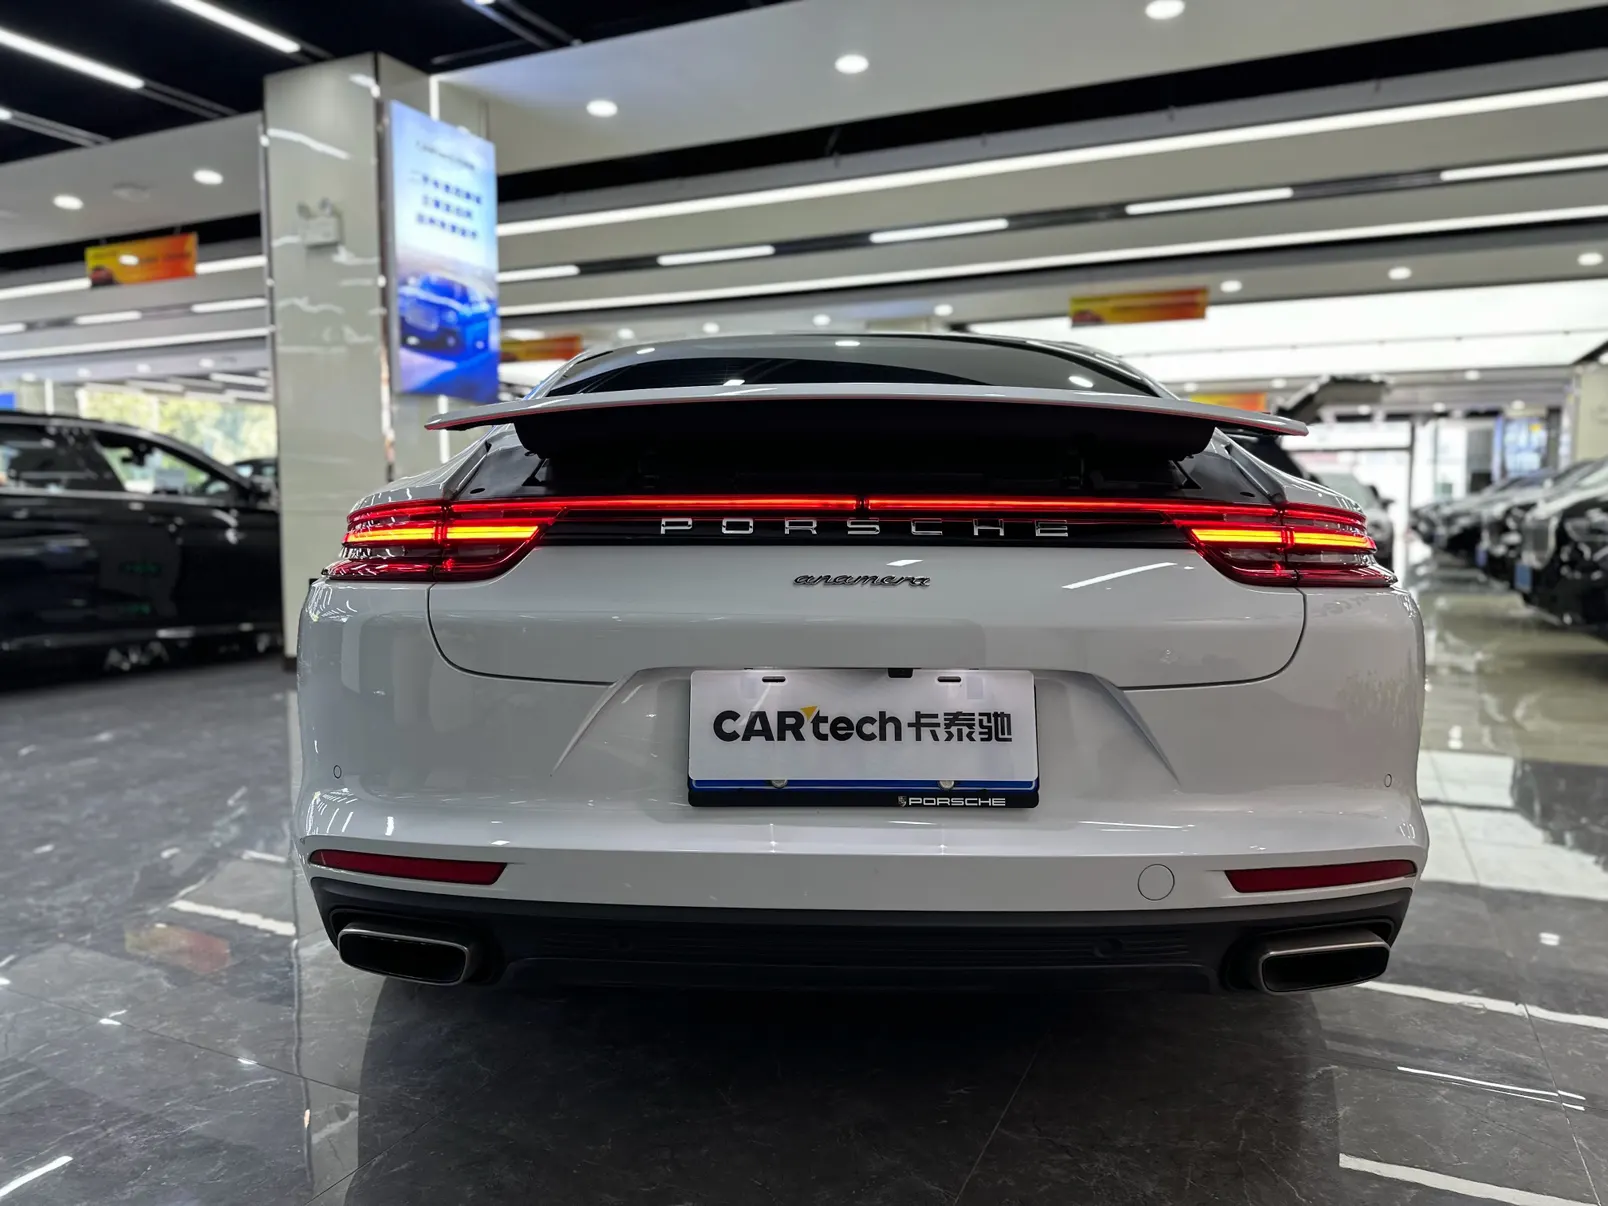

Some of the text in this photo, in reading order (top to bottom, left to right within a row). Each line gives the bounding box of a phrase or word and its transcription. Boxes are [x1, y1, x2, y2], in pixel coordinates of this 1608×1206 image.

[660, 517, 1070, 538] PORSCHE
[713, 709, 902, 742] CARtech
[908, 797, 1006, 807] PORSCHE
